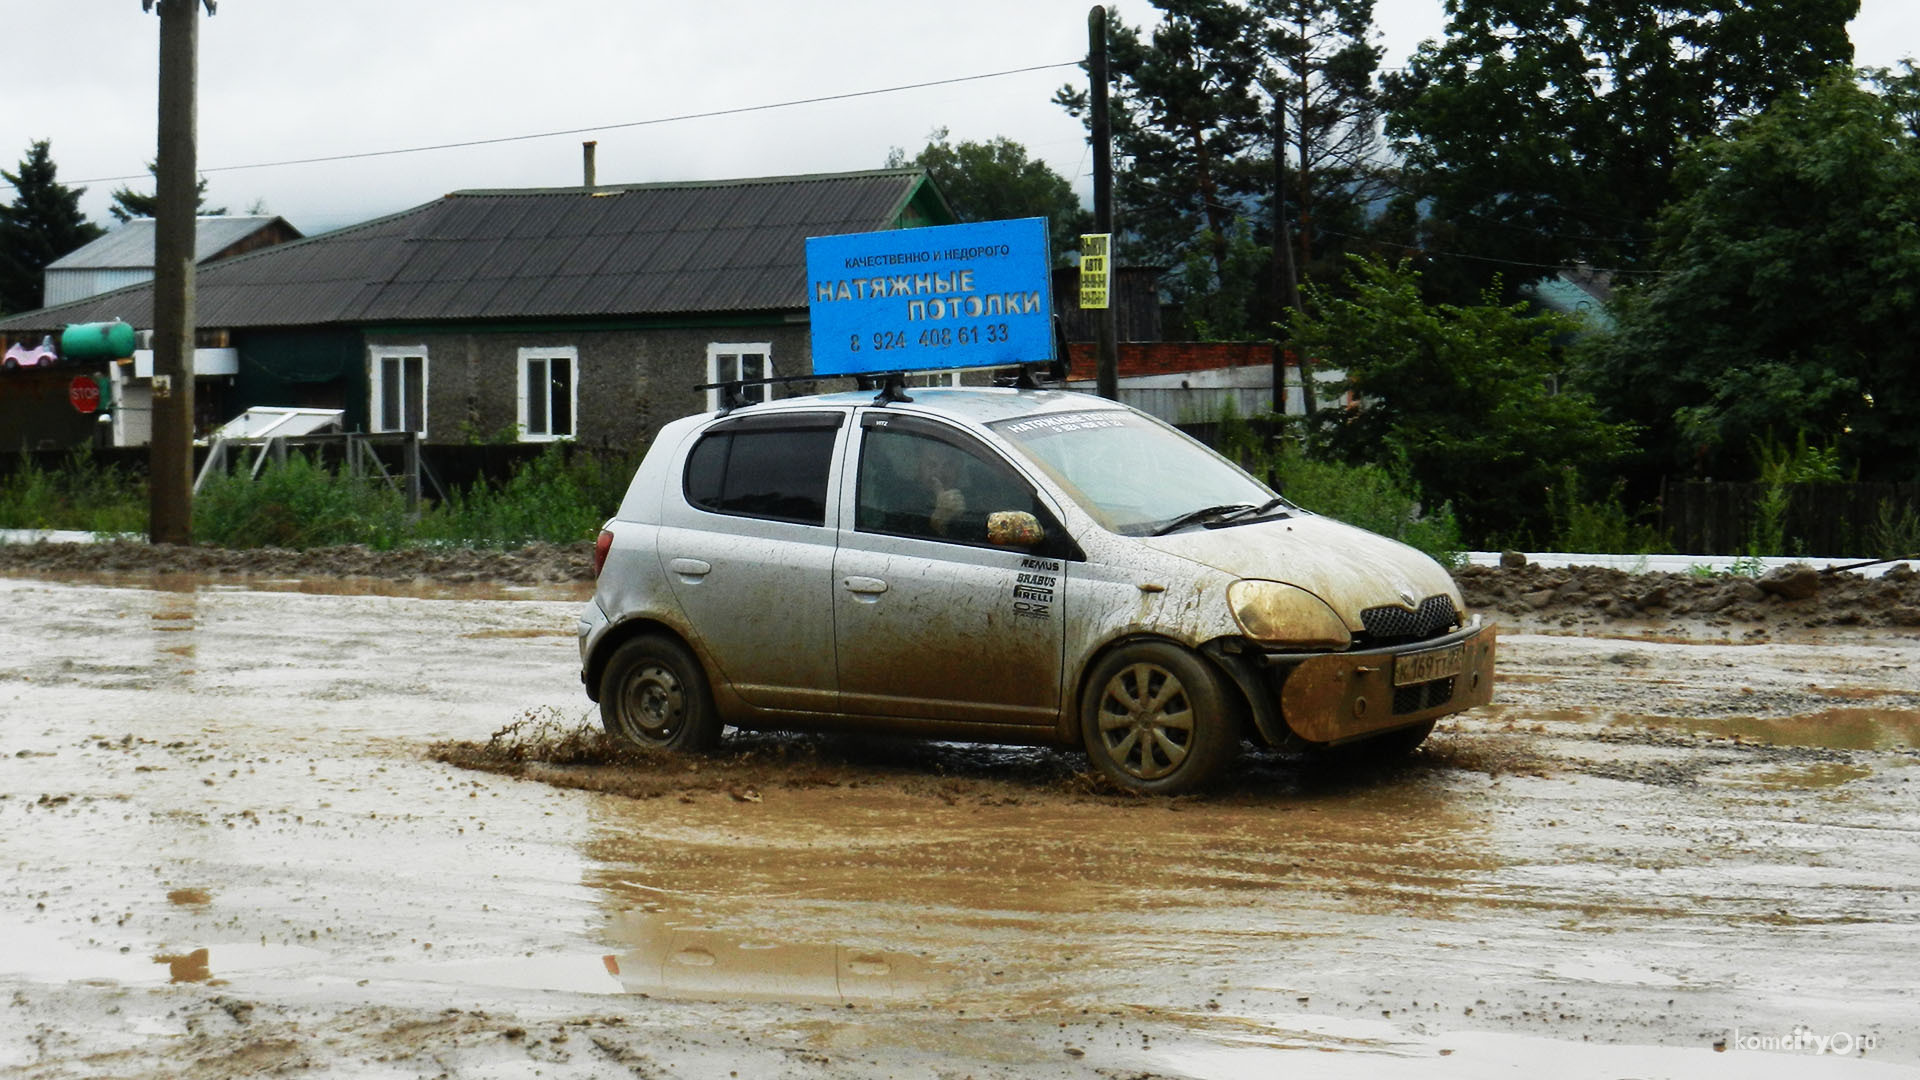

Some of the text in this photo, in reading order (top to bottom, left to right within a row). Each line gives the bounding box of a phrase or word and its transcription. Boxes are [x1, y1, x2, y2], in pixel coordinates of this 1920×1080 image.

[845, 244, 1010, 268] КАЧЕСТВЕННО И НЕДОРОГО
[815, 269, 976, 302] НАТЯЖНЫЕ
[908, 290, 1041, 321] ПОТОЛКИ
[850, 323, 1009, 352] 8 924 408 61 33
[71, 387, 99, 400] STOP
[1021, 559, 1059, 571] REMUS
[1016, 573, 1056, 587] BRABUS
[1013, 585, 1053, 602] PIRELLI
[1014, 602, 1049, 614] OZ
